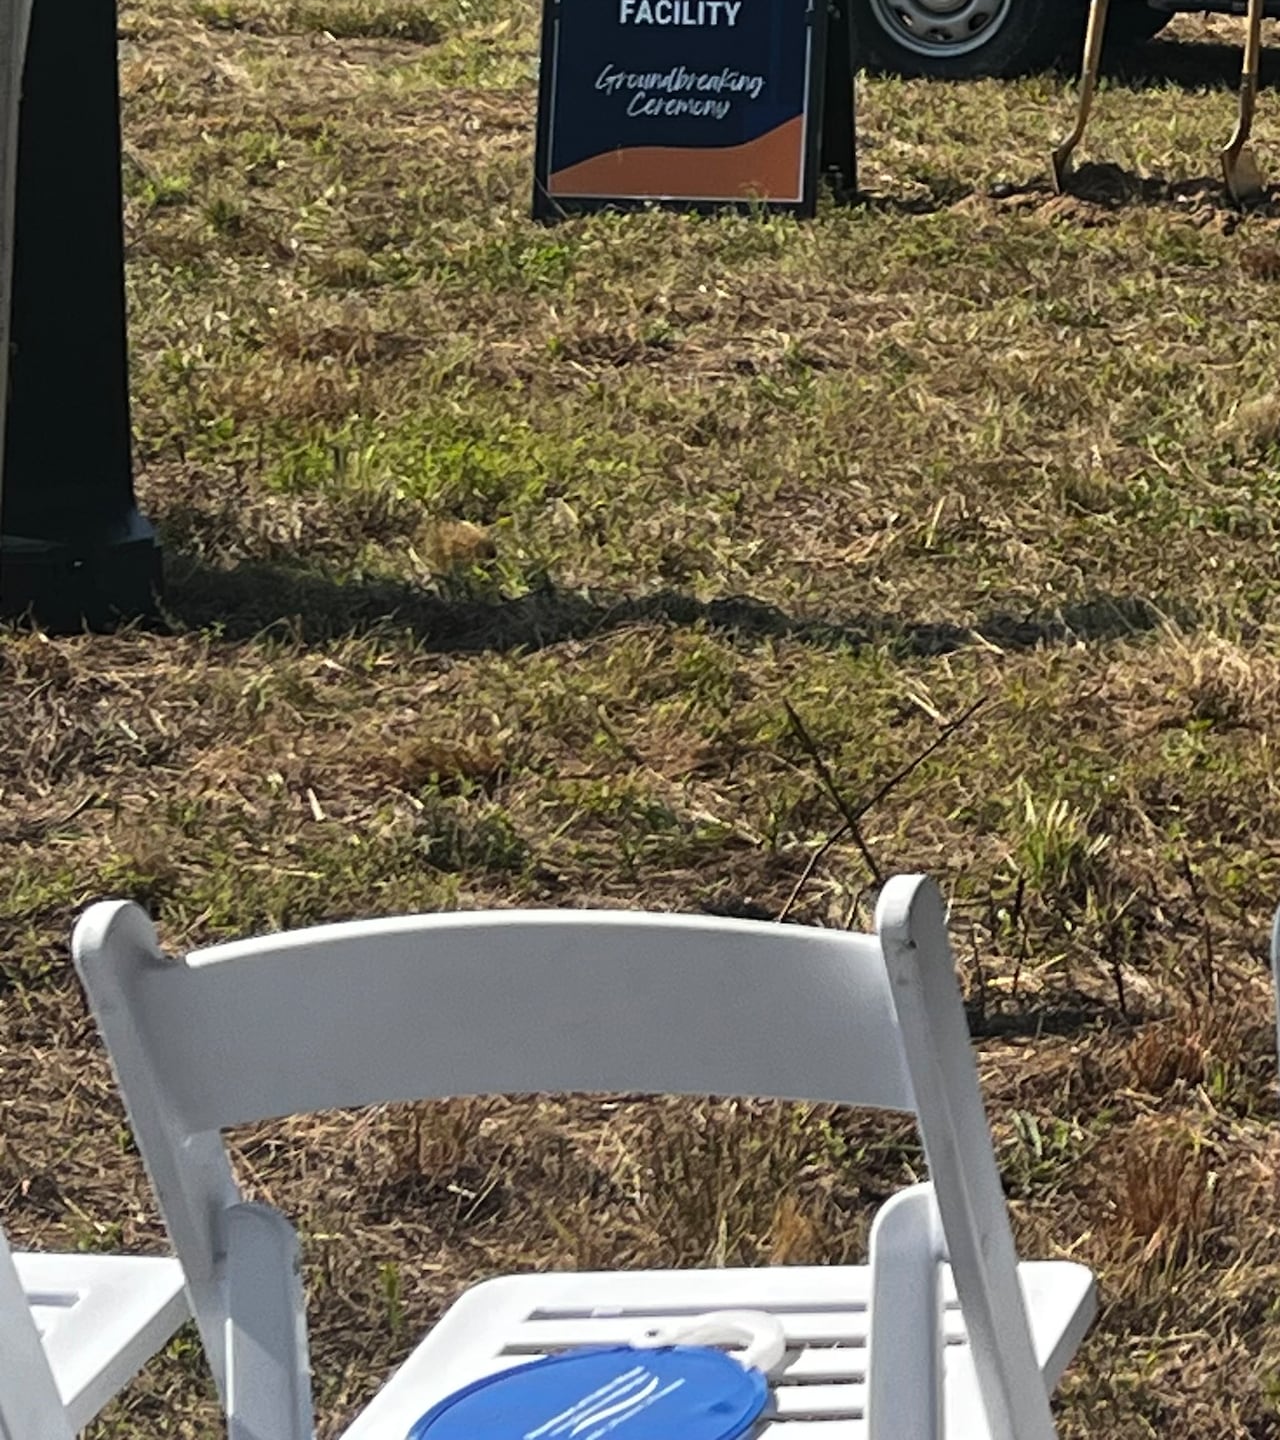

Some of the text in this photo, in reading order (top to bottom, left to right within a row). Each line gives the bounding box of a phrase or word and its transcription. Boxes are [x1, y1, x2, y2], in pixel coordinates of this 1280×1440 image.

[619, 0, 742, 26] FACILITY
[595, 63, 766, 99] Groundbreaking
[627, 91, 731, 120] Ceremony
